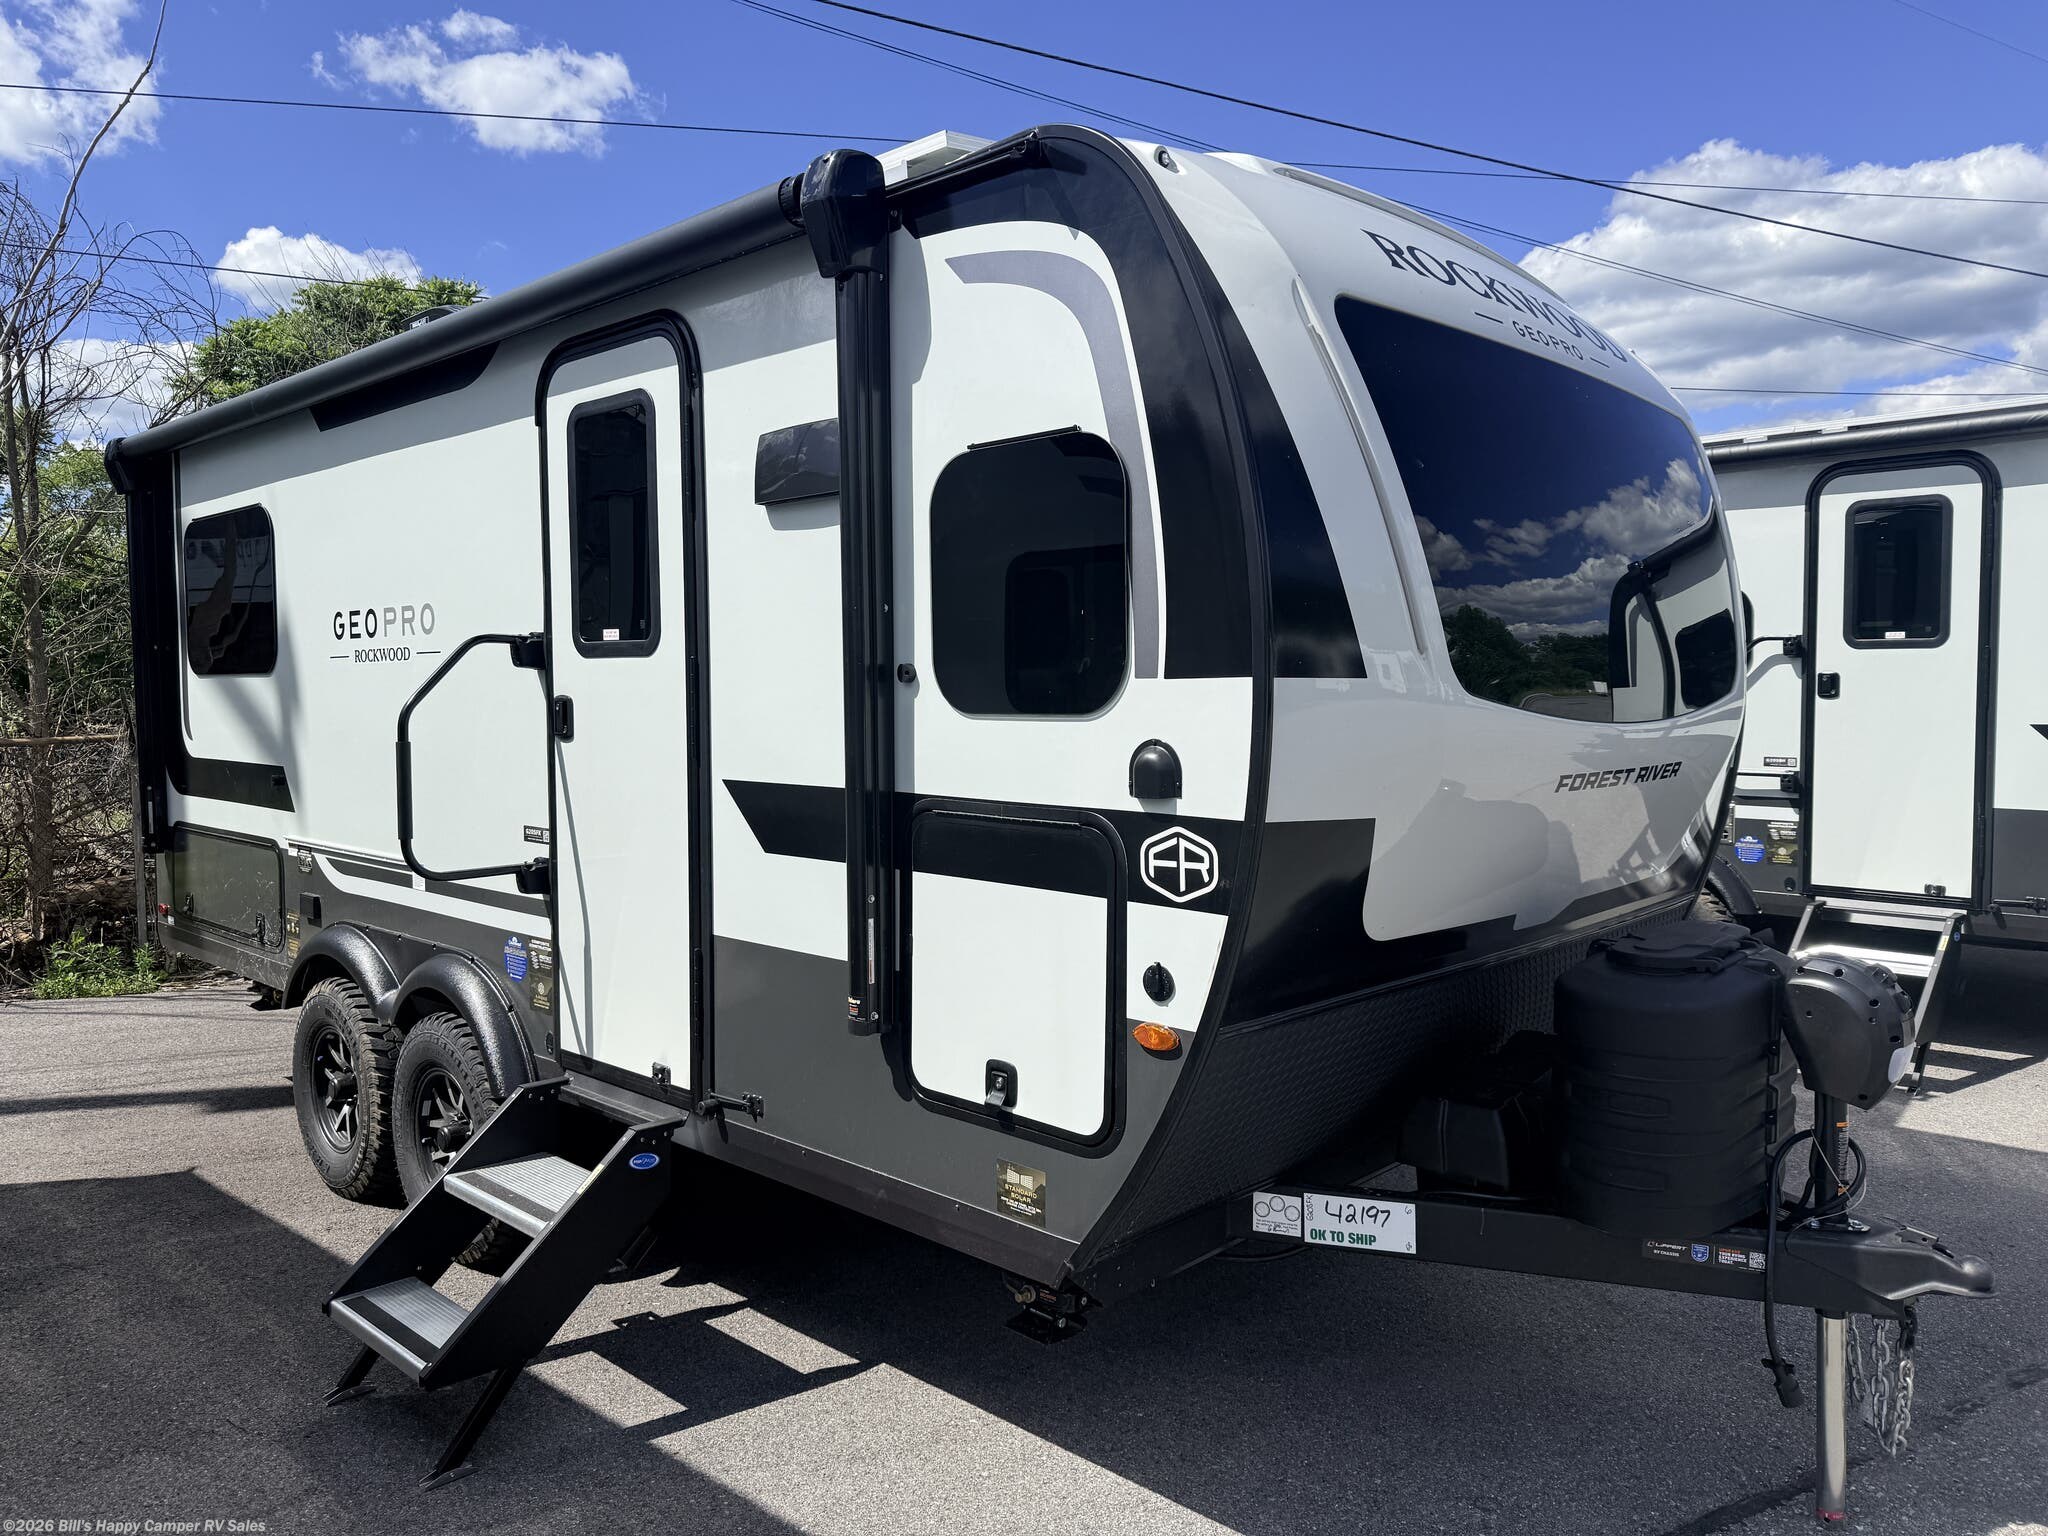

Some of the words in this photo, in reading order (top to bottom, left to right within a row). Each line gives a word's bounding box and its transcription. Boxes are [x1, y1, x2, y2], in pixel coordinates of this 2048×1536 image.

[1361, 228, 1628, 363] ROCKWOOD
[1512, 320, 1583, 361] GEOPRO
[354, 647, 411, 663] ROCKWOOD
[1554, 768, 1636, 793] FOREST
[1633, 761, 1683, 783] RIVER
[1324, 1200, 1391, 1229] 42197
[1309, 1228, 1327, 1241] OK
[1329, 1230, 1345, 1243] TO
[1347, 1232, 1377, 1246] SHIP
